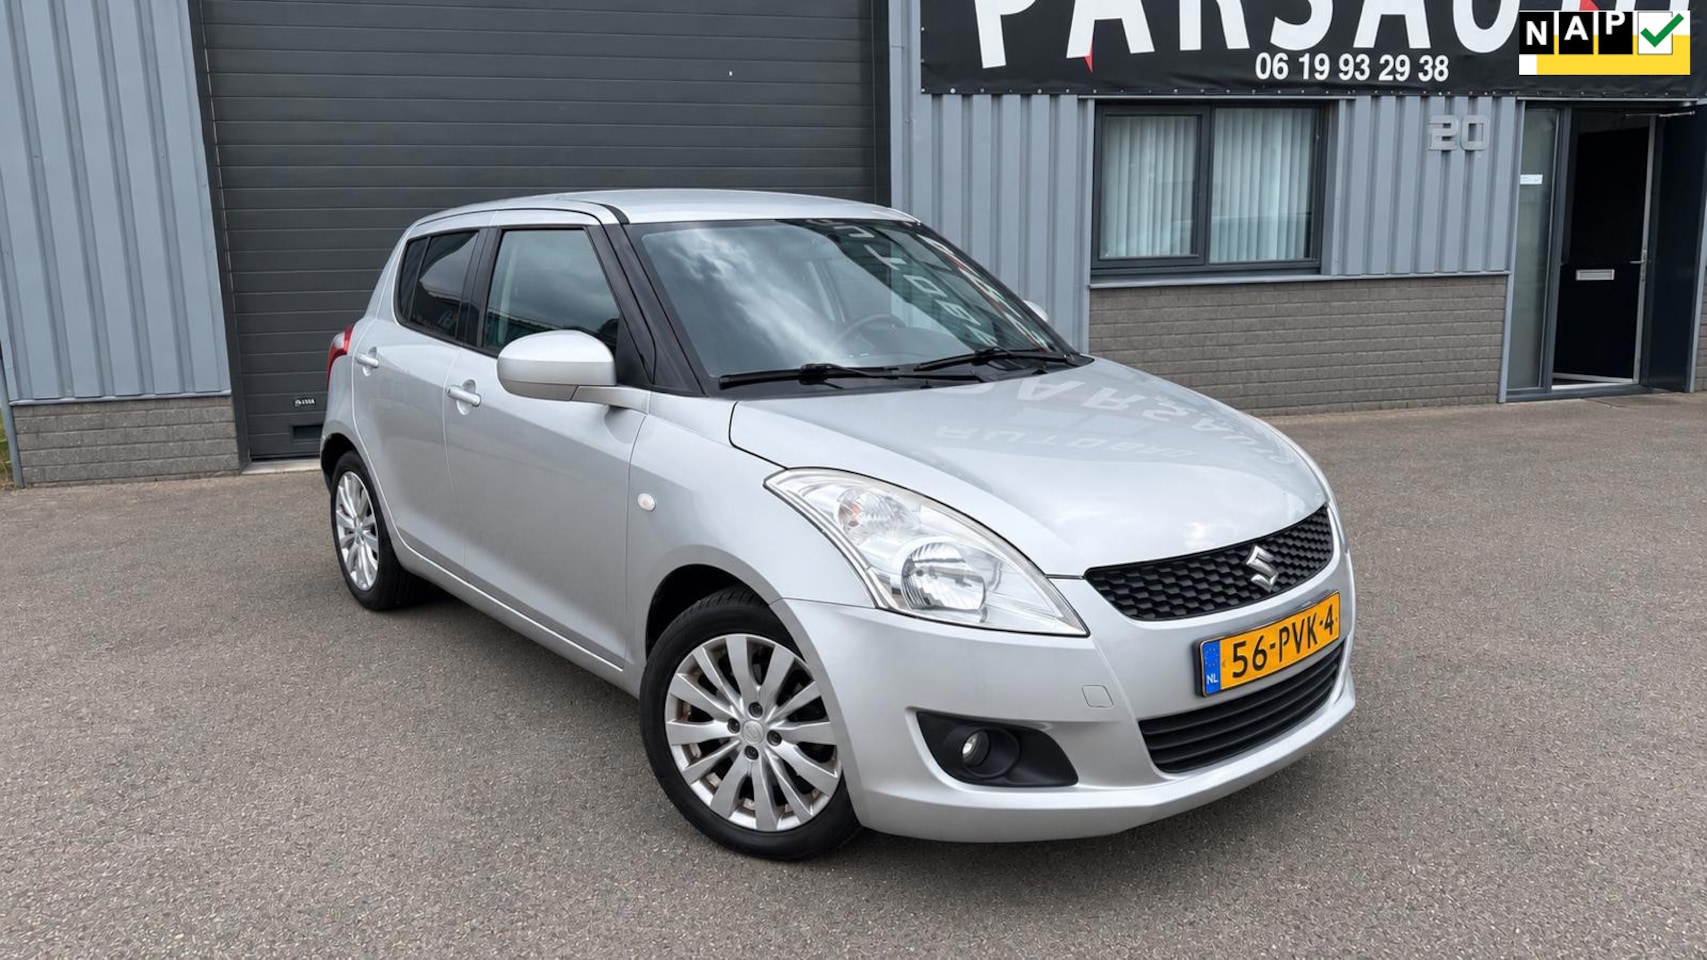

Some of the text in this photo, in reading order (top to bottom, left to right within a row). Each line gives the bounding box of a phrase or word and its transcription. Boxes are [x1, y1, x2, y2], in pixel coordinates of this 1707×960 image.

[1255, 52, 1449, 82] 06 19 93 29 38
[1428, 115, 1490, 151] 20
[1232, 604, 1333, 678] 56-PVK-4
[1206, 673, 1219, 685] NL
